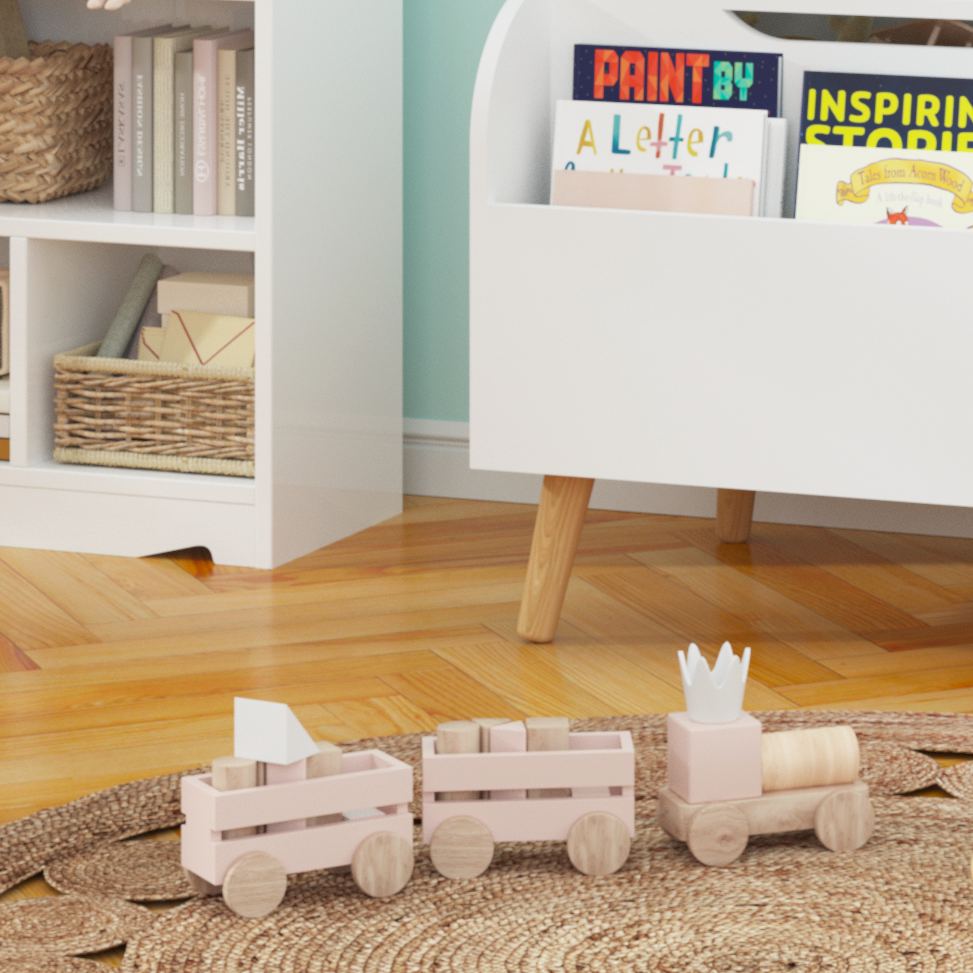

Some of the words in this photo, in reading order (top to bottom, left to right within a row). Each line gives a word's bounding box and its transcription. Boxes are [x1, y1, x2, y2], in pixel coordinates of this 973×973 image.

[593, 49, 710, 104] PAINT
[713, 61, 754, 101] BY
[576, 120, 597, 155] A
[612, 113, 733, 159] Letter
[857, 170, 881, 185] Tales
[884, 164, 905, 179] from
[909, 164, 936, 181] Acorn
[939, 168, 965, 192] Wood
[876, 193, 883, 202] A
[927, 196, 942, 207] book
